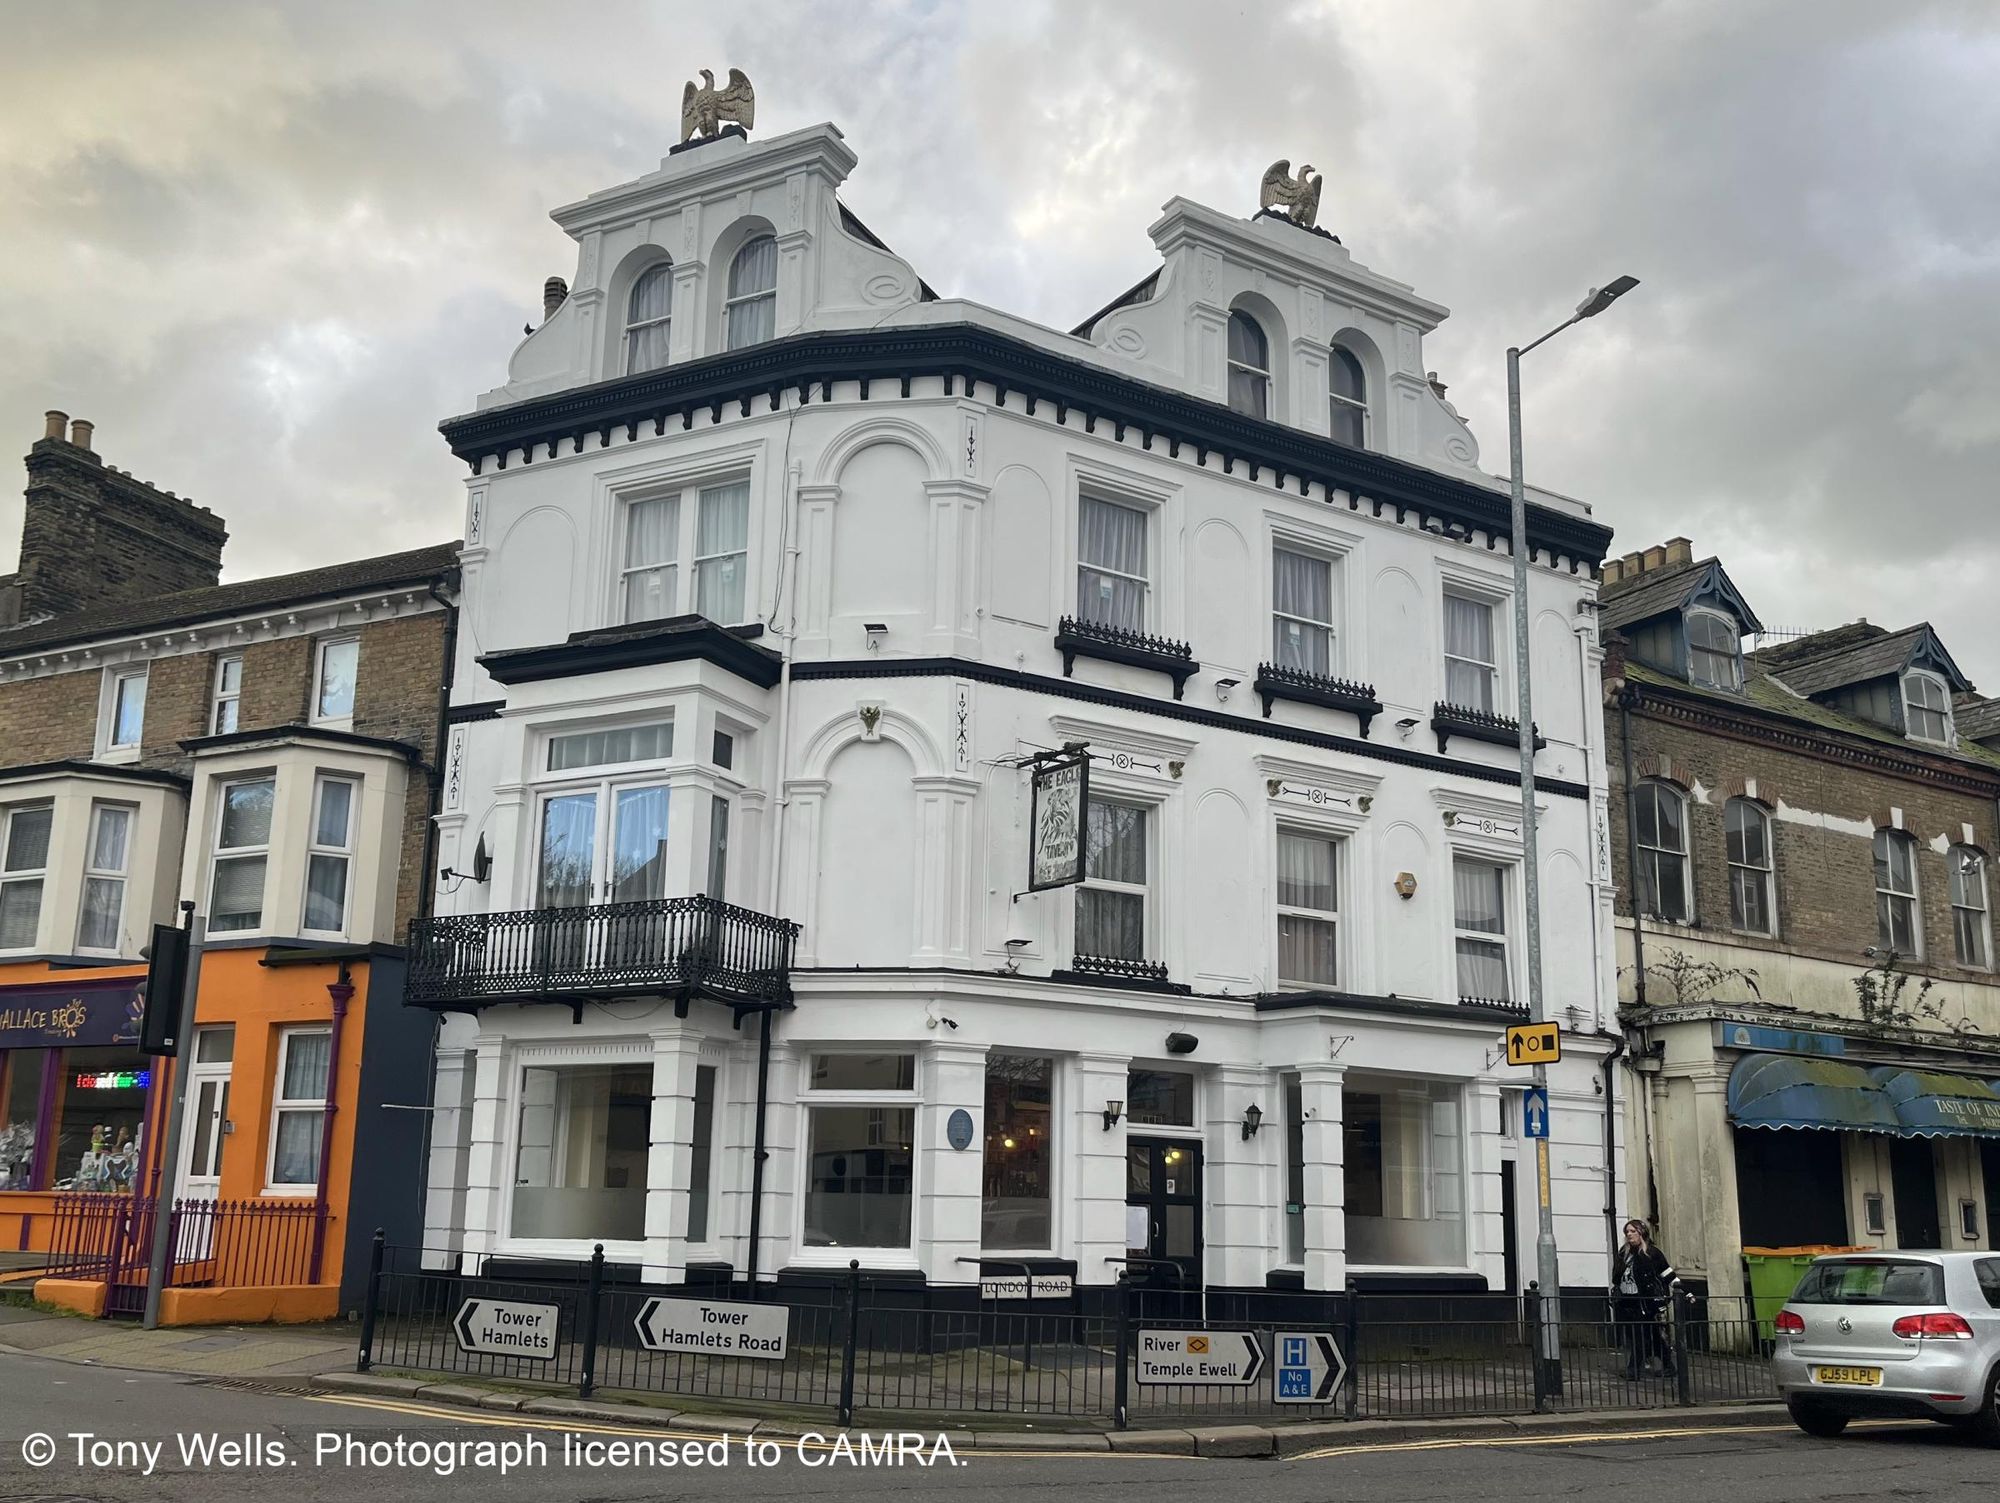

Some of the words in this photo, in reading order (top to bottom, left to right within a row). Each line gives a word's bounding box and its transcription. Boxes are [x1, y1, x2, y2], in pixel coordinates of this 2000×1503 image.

[52, 1007, 87, 1028] BROS
[1934, 1100, 1966, 1114] TASTE
[1966, 1102, 1981, 1115] OF
[1037, 1281, 1068, 1292] ROAD
[494, 1308, 542, 1327] Tower
[700, 1308, 748, 1325] Tower
[482, 1327, 549, 1348] Hamlets
[662, 1328, 732, 1348] Hamlets
[738, 1334, 782, 1352] Road
[1144, 1337, 1181, 1351] River
[1286, 1340, 1303, 1363] H
[1143, 1362, 1193, 1378] Temple
[1199, 1363, 1237, 1376] Ewell
[1288, 1372, 1302, 1382] No
[1820, 1369, 1849, 1380] GJ59
[1851, 1370, 1875, 1382] LPL
